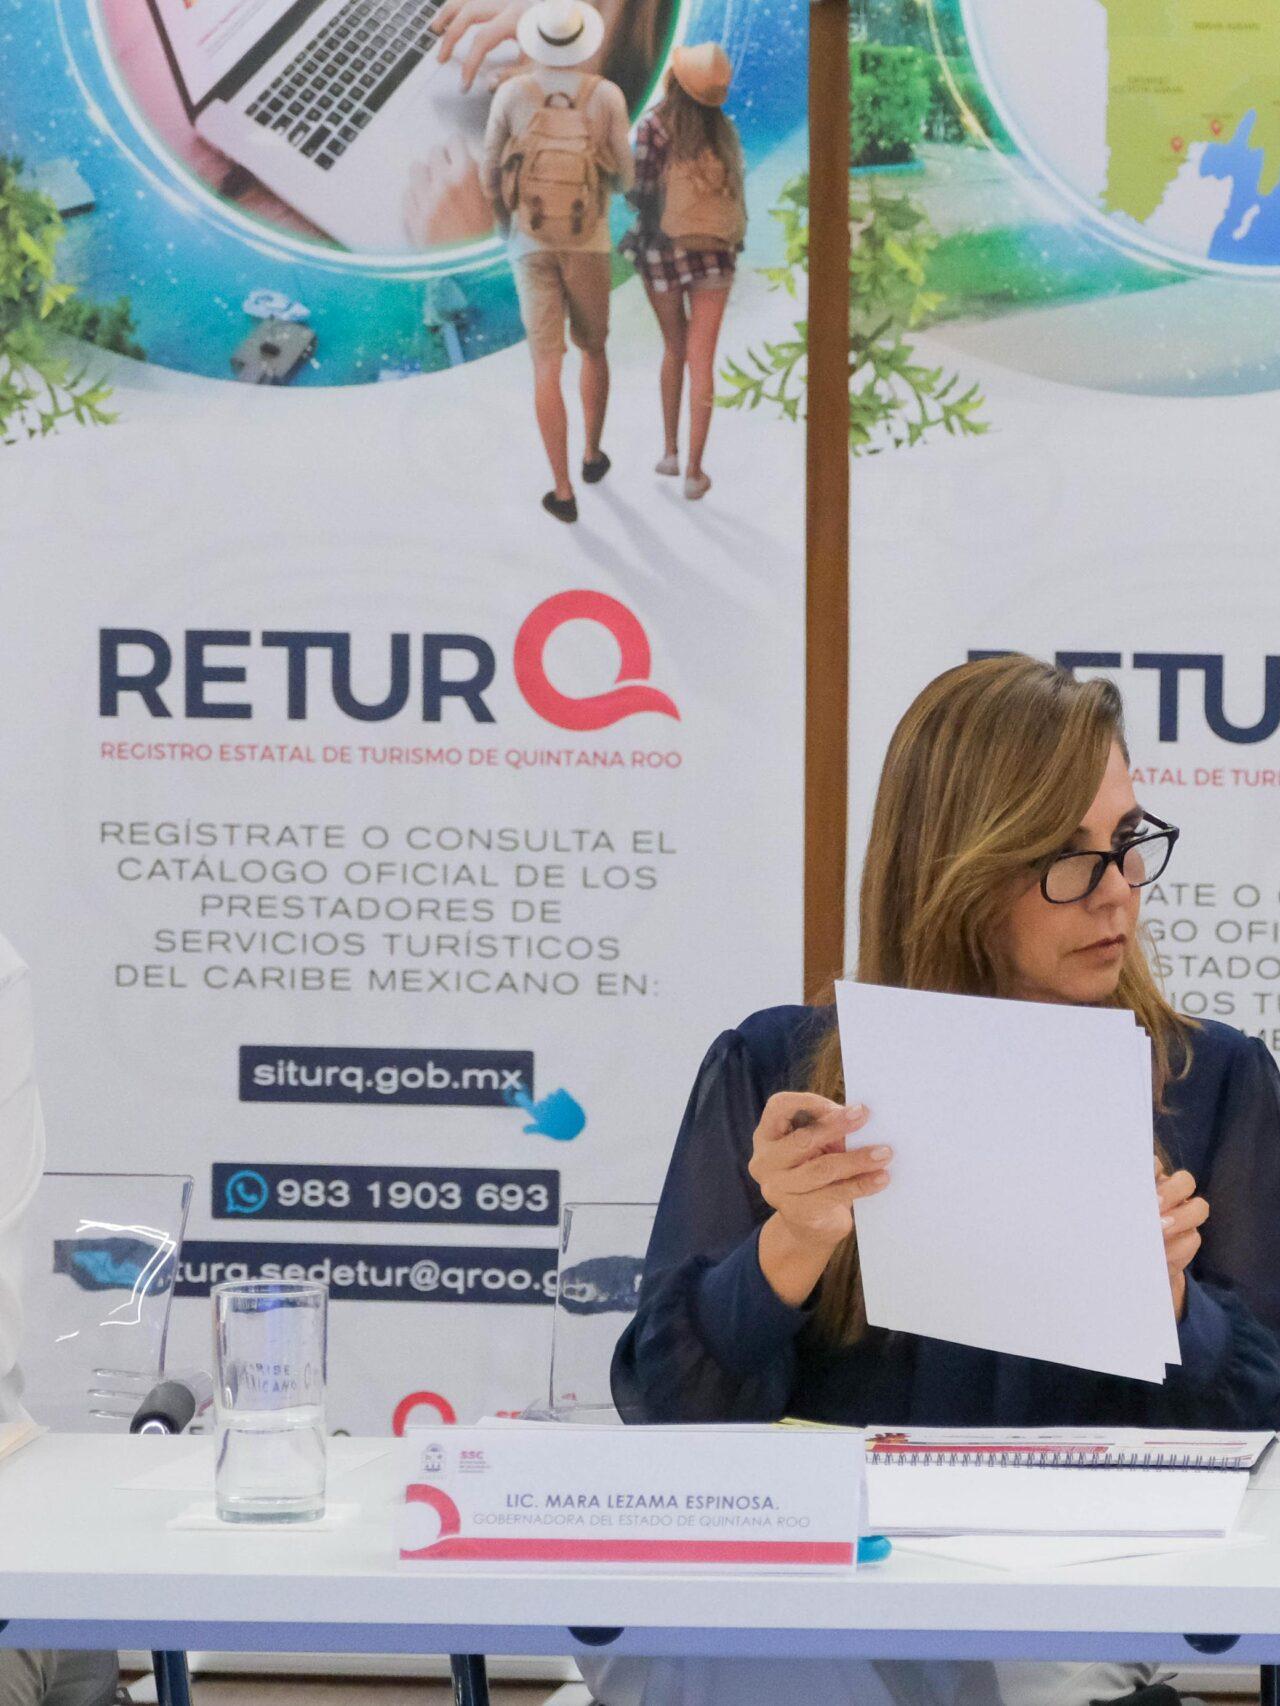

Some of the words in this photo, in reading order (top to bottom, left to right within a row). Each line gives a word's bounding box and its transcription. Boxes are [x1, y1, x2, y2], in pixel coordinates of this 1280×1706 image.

[100, 742, 212, 762] REGISTRO
[219, 743, 316, 764] ESTATAL
[321, 745, 353, 764] DE
[358, 745, 462, 766] TURISMO
[469, 747, 499, 767] DE
[504, 748, 626, 771] QUINTANA
[631, 750, 682, 769] ROO
[1131, 767, 1187, 787] ATAL
[1193, 767, 1224, 787] DE
[99, 817, 345, 850] REGÍSTRATE
[361, 825, 390, 850] O
[405, 826, 614, 854] CONSULTA
[631, 830, 677, 855] EL
[116, 854, 329, 885] CATÁLOGO
[344, 861, 499, 888] OFICIAL
[515, 864, 565, 889] DE
[581, 865, 659, 891] LOS
[200, 894, 495, 924] PRESTADORES
[511, 899, 562, 924] DE
[1232, 883, 1261, 909] O
[154, 929, 366, 957] SERVICIOS
[382, 929, 621, 962] TURÍSTICOS
[114, 964, 187, 990] DEL
[203, 966, 352, 993] CARIBE
[368, 969, 581, 997] MEXICANO
[597, 973, 659, 998] EN:
[252, 1059, 524, 1095] siturq.gob.mx
[276, 1178, 351, 1208] 983
[366, 1181, 462, 1211] 1903
[475, 1183, 549, 1213] 693
[506, 1493, 538, 1509] LIC.
[545, 1494, 600, 1509] MARA
[607, 1494, 679, 1510] LEZAMA
[685, 1495, 780, 1511] ESPINOSA.
[472, 1513, 584, 1526] GOBERNADORA
[590, 1514, 613, 1527] DEL
[618, 1514, 673, 1527] ESTADO
[677, 1514, 696, 1528] DE
[699, 1515, 772, 1528] QUINTANA
[777, 1516, 811, 1528] ROO
